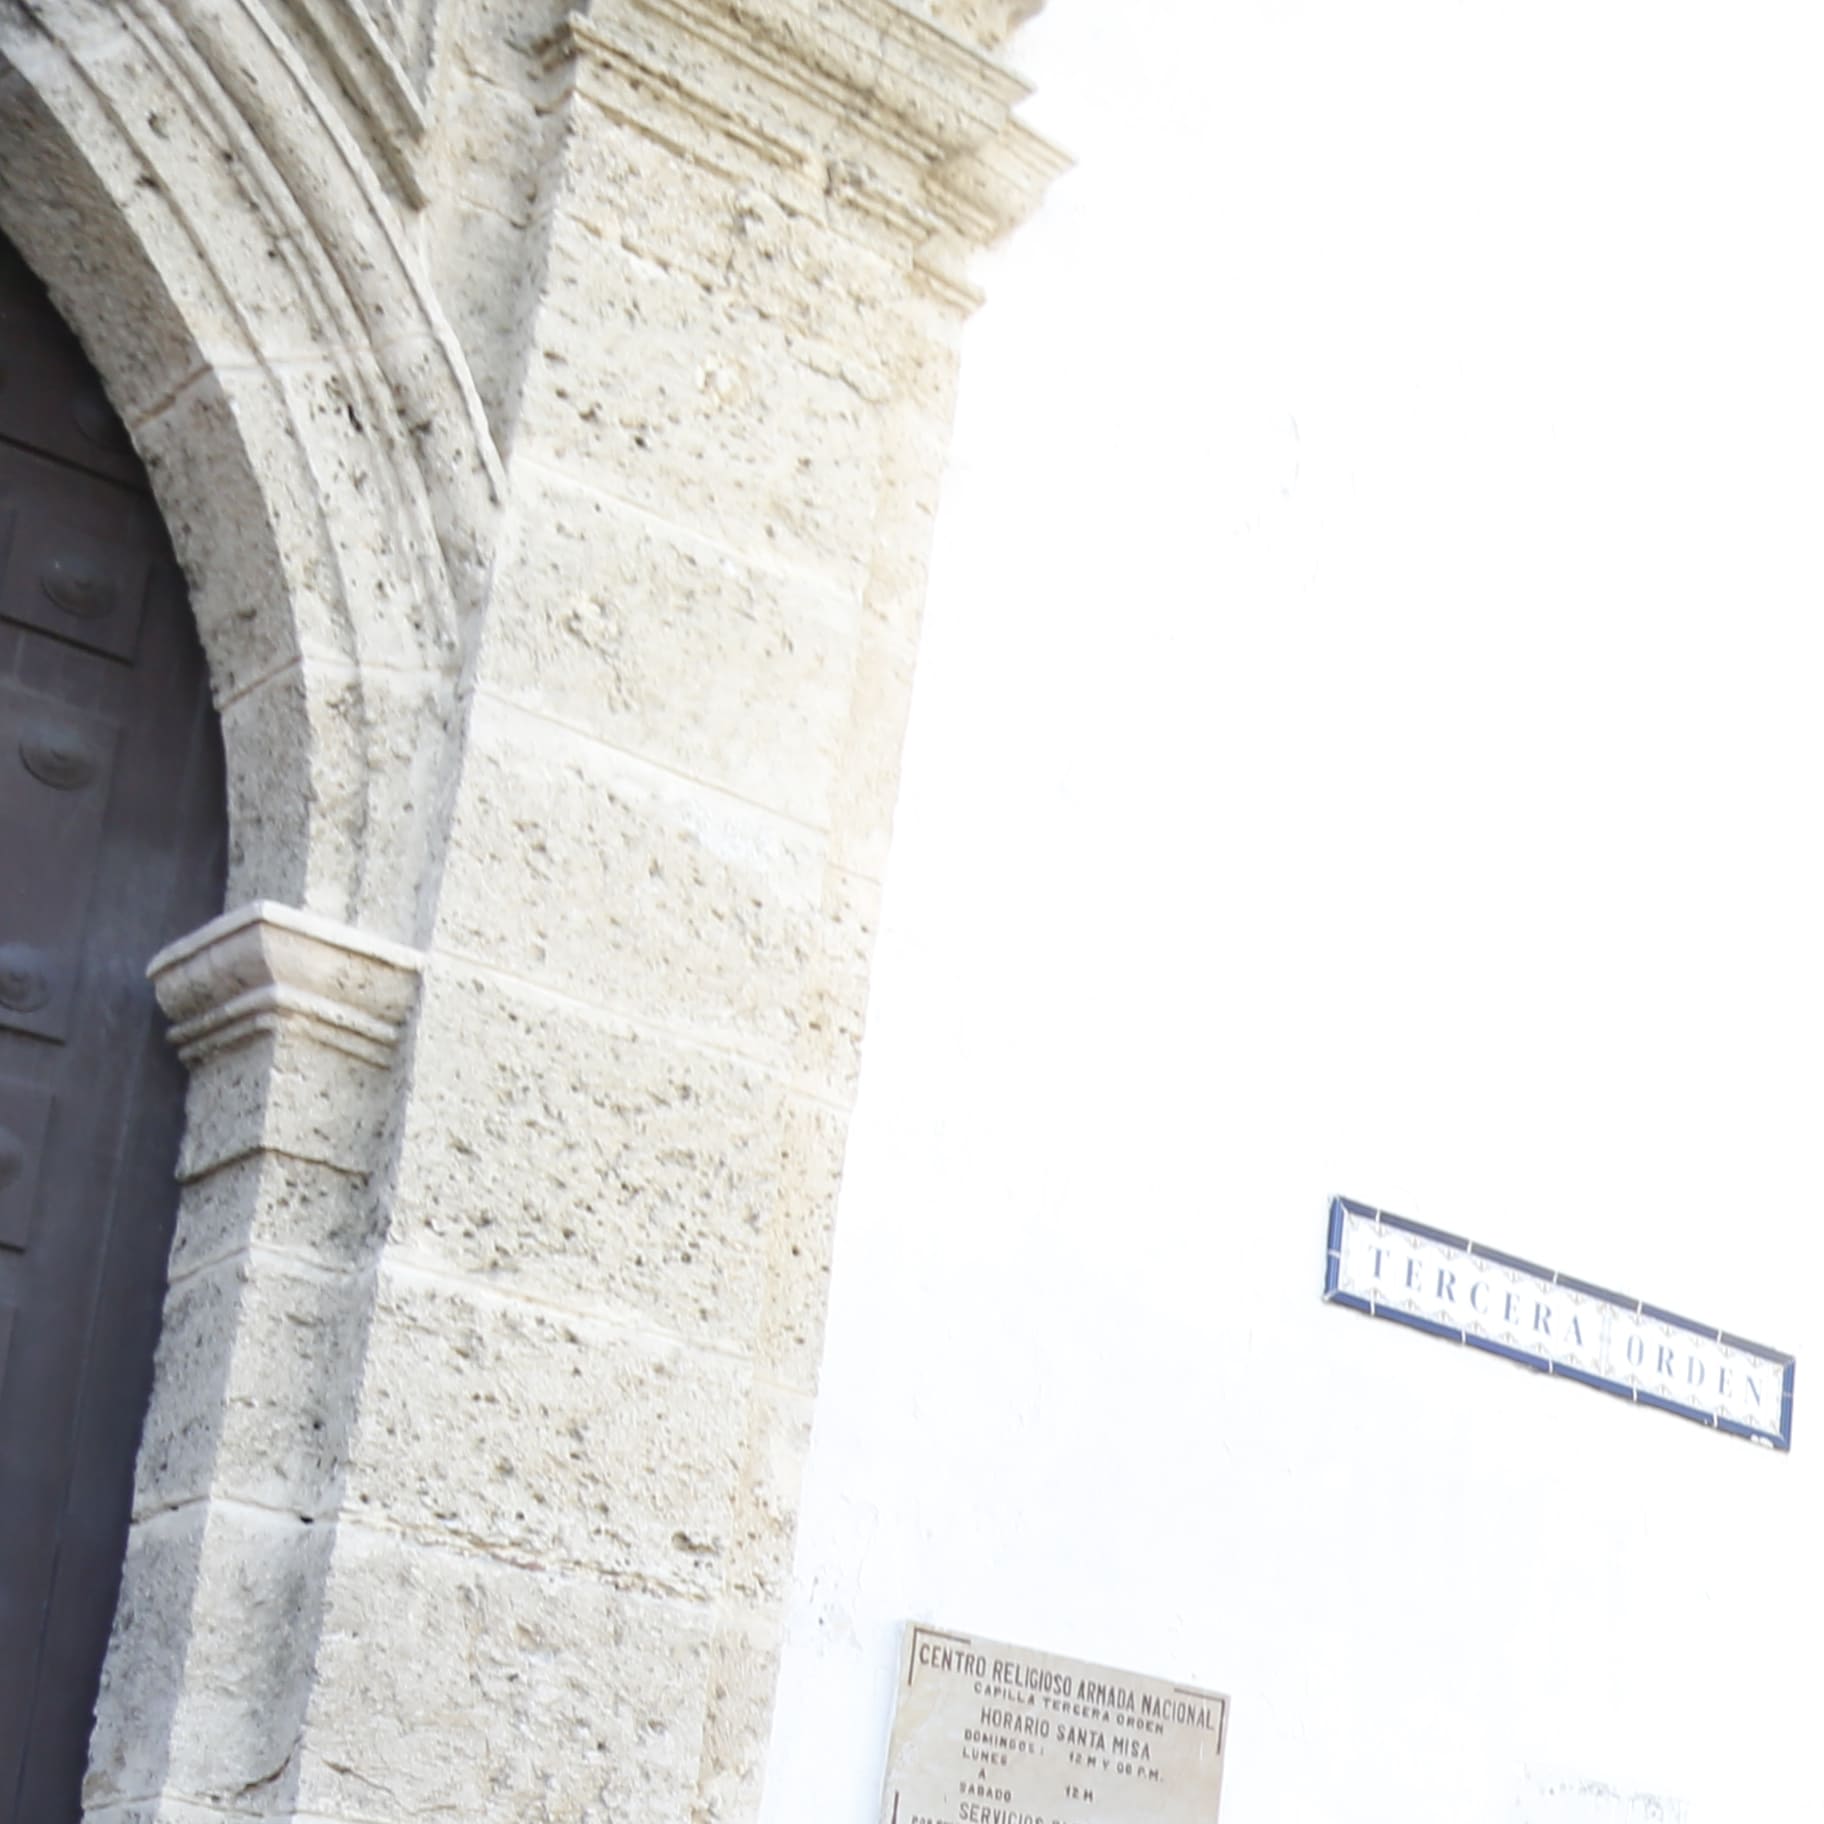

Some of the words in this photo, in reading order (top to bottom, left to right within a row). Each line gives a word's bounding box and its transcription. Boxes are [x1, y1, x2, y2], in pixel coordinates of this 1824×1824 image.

[1367, 1243, 1587, 1349] TERCERA
[1625, 1332, 1765, 1408] ORDEN
[919, 1642, 987, 1678] CENTRO
[992, 1658, 1072, 1697] RELIGIOSO
[1076, 1679, 1136, 1713] ARMADA
[1141, 1693, 1214, 1730] NACIONAL
[973, 1681, 1036, 1705] CAPILLA
[1043, 1697, 1110, 1723] TERCERA
[1116, 1712, 1165, 1736] ORDEN
[961, 1745, 1008, 1767] LUNES
[980, 1705, 1051, 1739] HORARIO
[1056, 1724, 1106, 1753] SANTA
[1112, 1735, 1151, 1761] MISA
[958, 1781, 1013, 1804] SABADO
